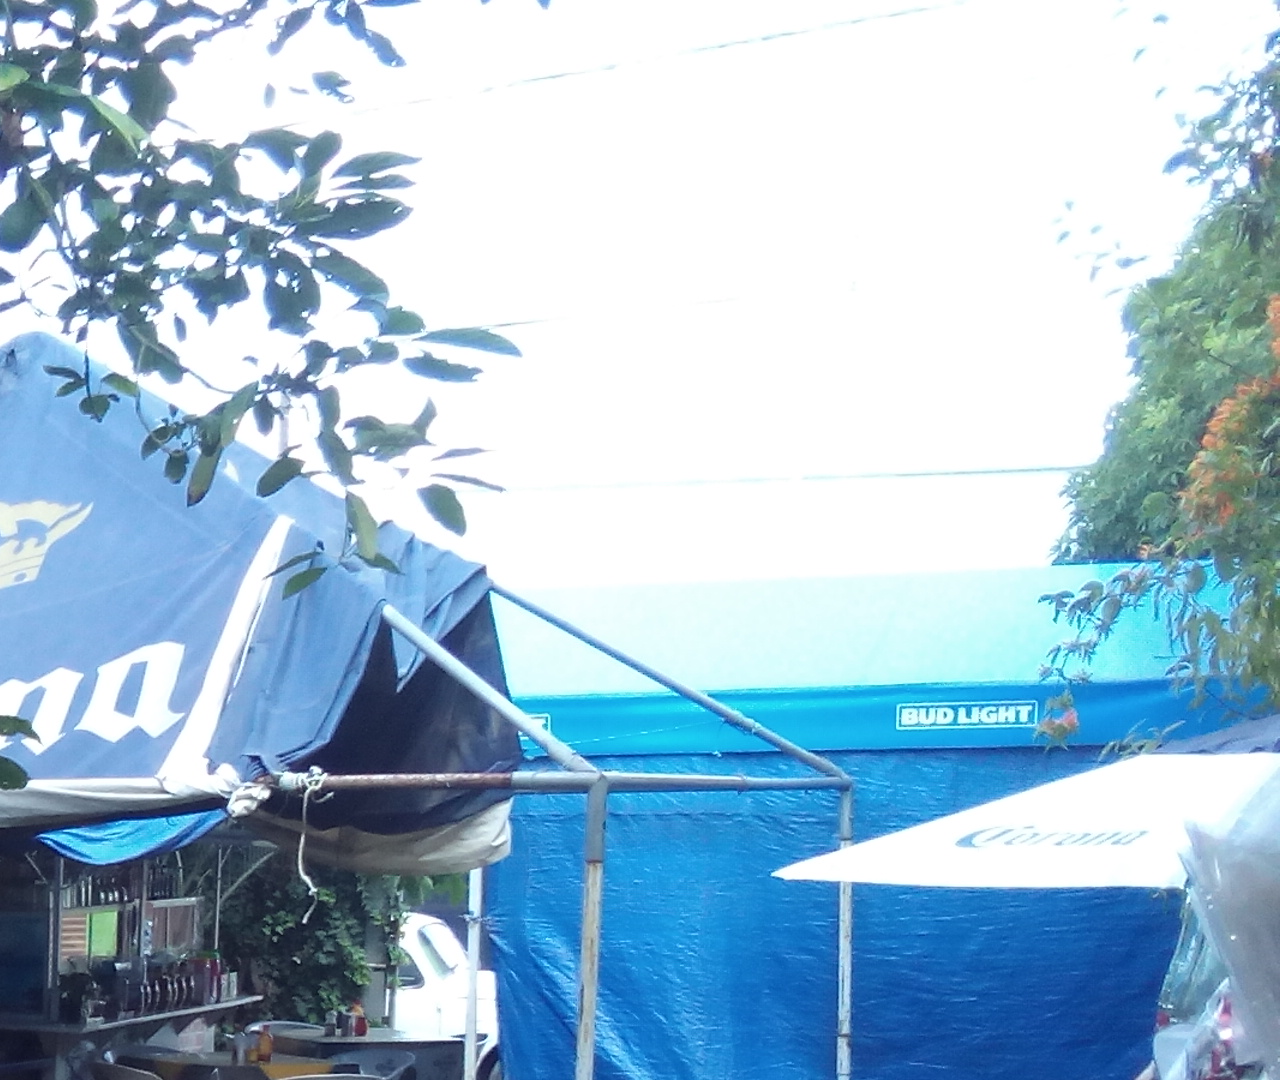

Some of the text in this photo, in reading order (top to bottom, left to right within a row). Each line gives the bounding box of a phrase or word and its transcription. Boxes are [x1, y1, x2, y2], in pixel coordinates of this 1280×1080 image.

[901, 705, 1033, 726] BUD LIGHT
[955, 826, 1149, 848] Corona
